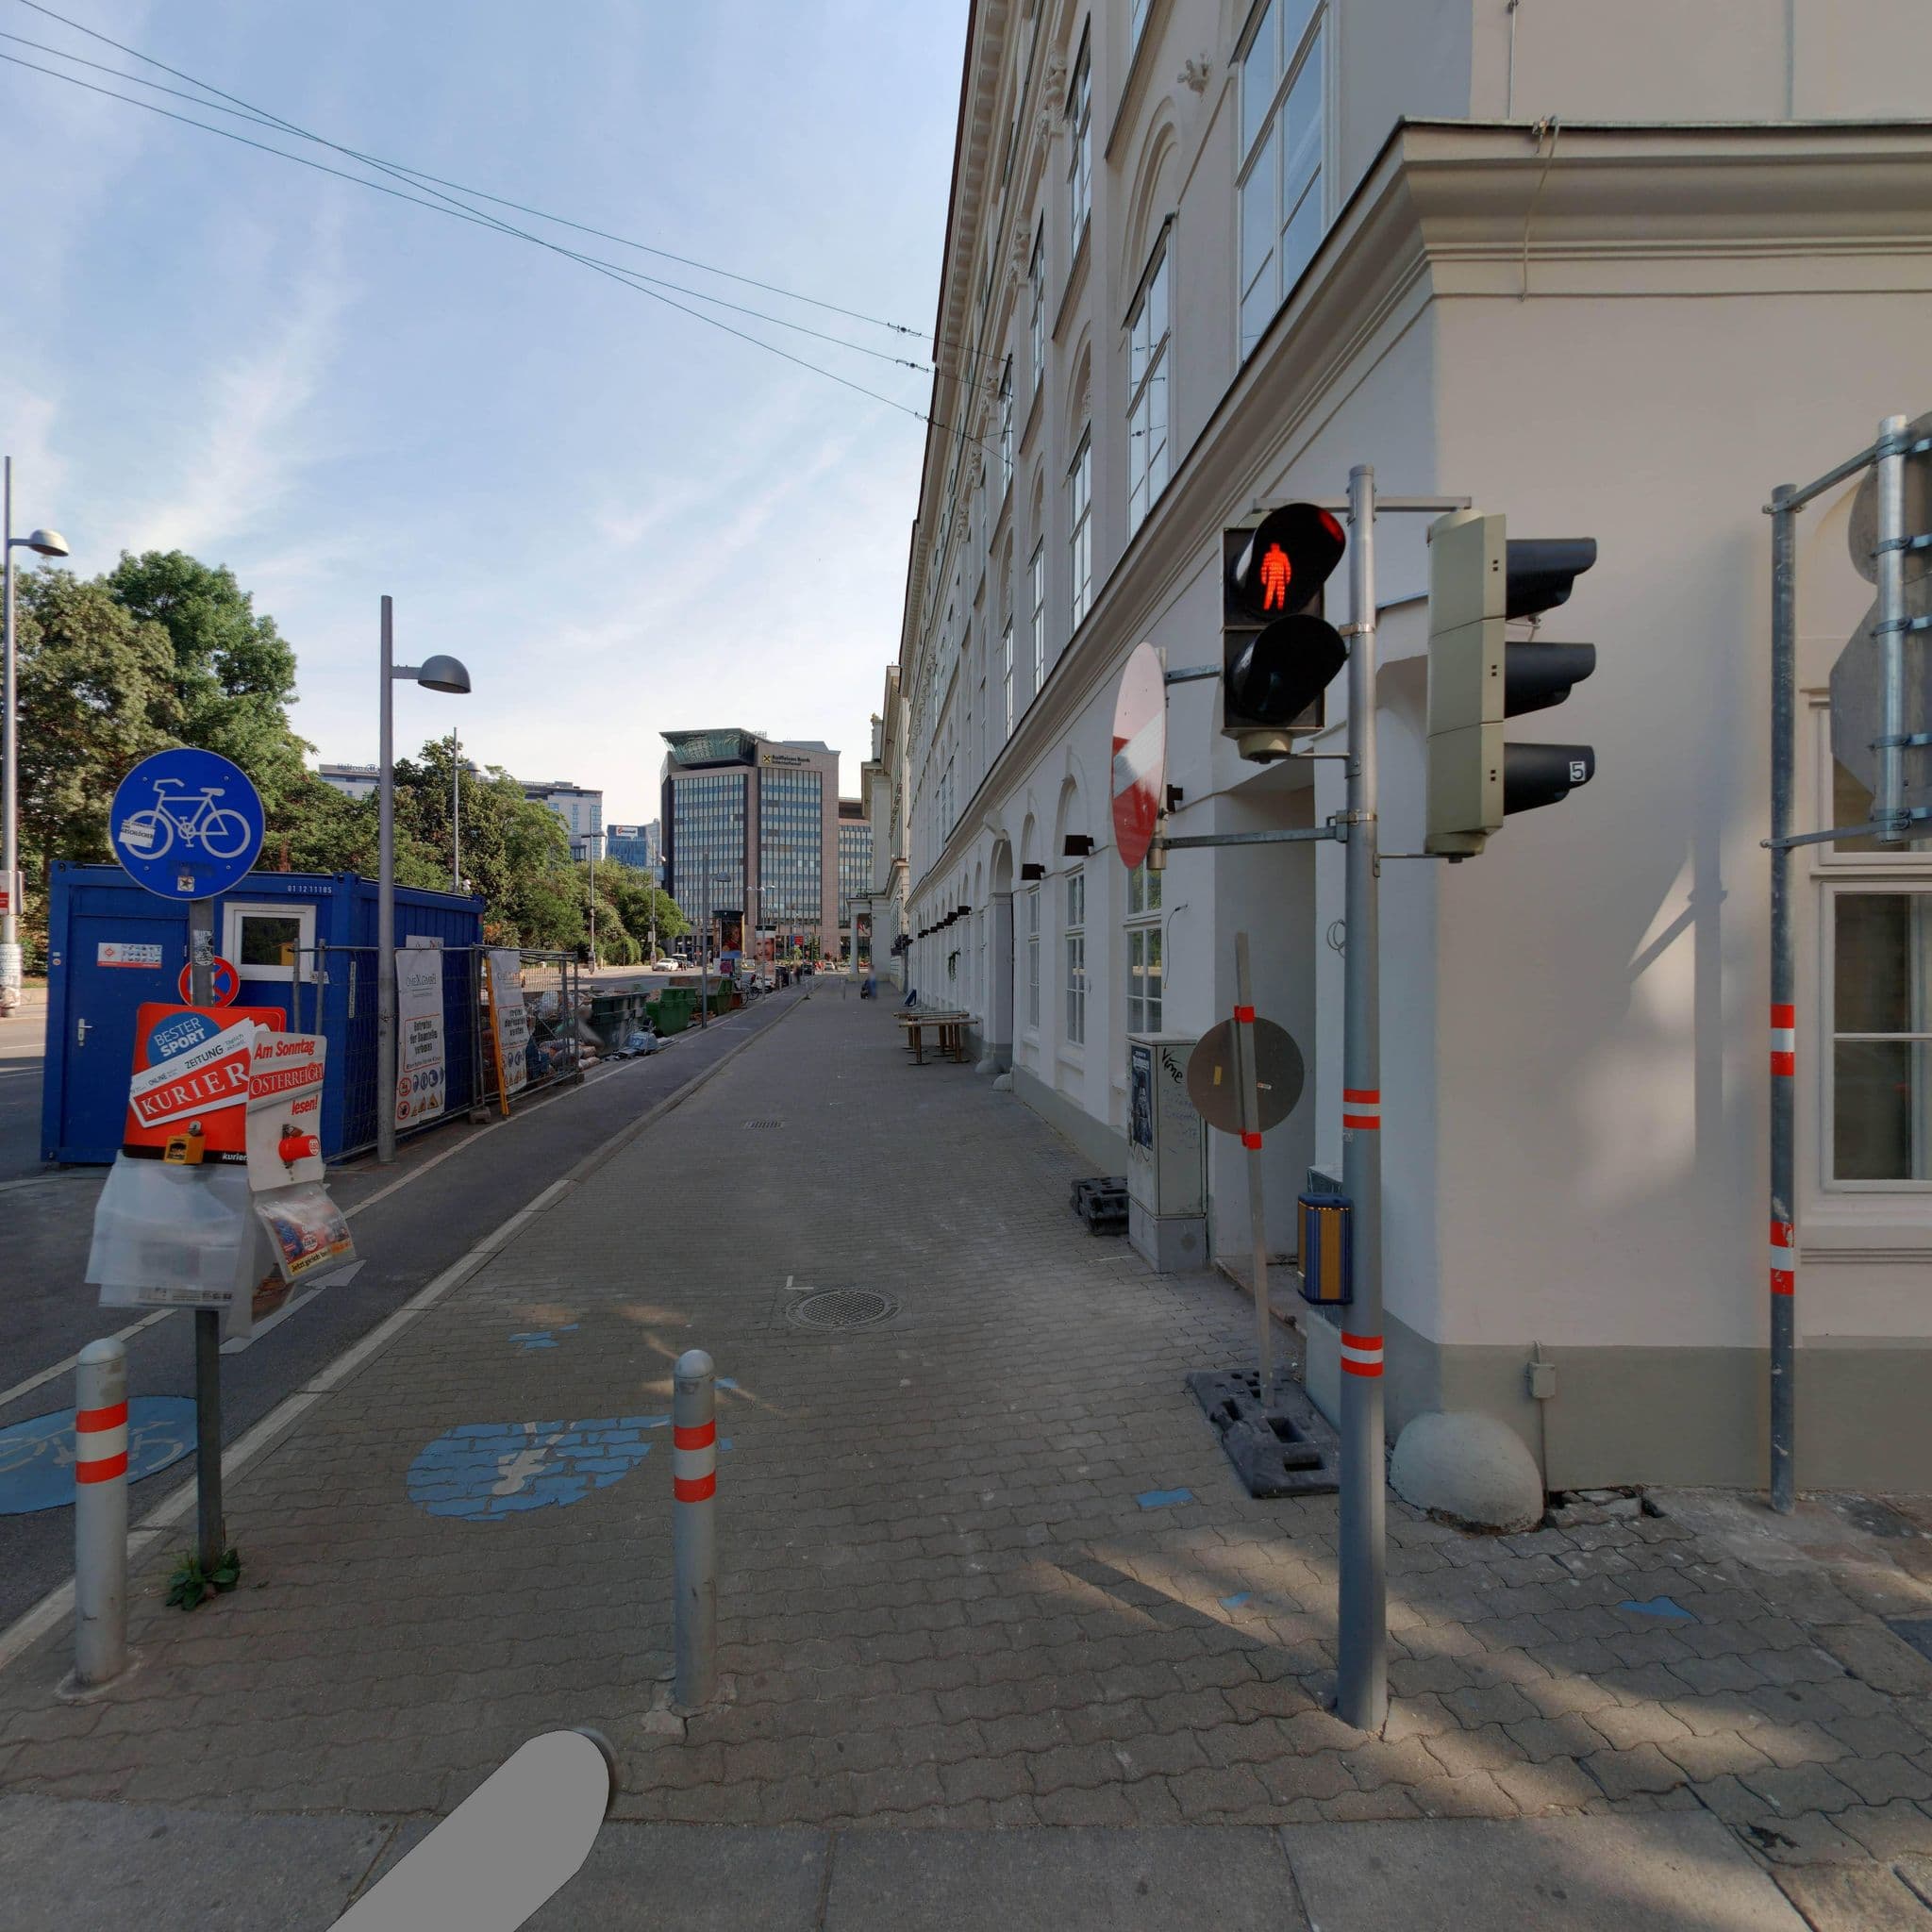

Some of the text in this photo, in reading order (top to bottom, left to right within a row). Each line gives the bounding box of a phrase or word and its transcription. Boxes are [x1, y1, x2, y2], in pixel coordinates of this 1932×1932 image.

[1571, 762, 1585, 780] 5
[154, 1017, 202, 1046] BESTER
[160, 1028, 206, 1058] SPORT
[184, 1044, 224, 1070] ZEITUNG
[254, 1039, 315, 1060] Am Sonntag
[141, 1062, 249, 1115] KURIER
[250, 1062, 324, 1095] ÖSTERREICH
[291, 1094, 319, 1116] lesen!
